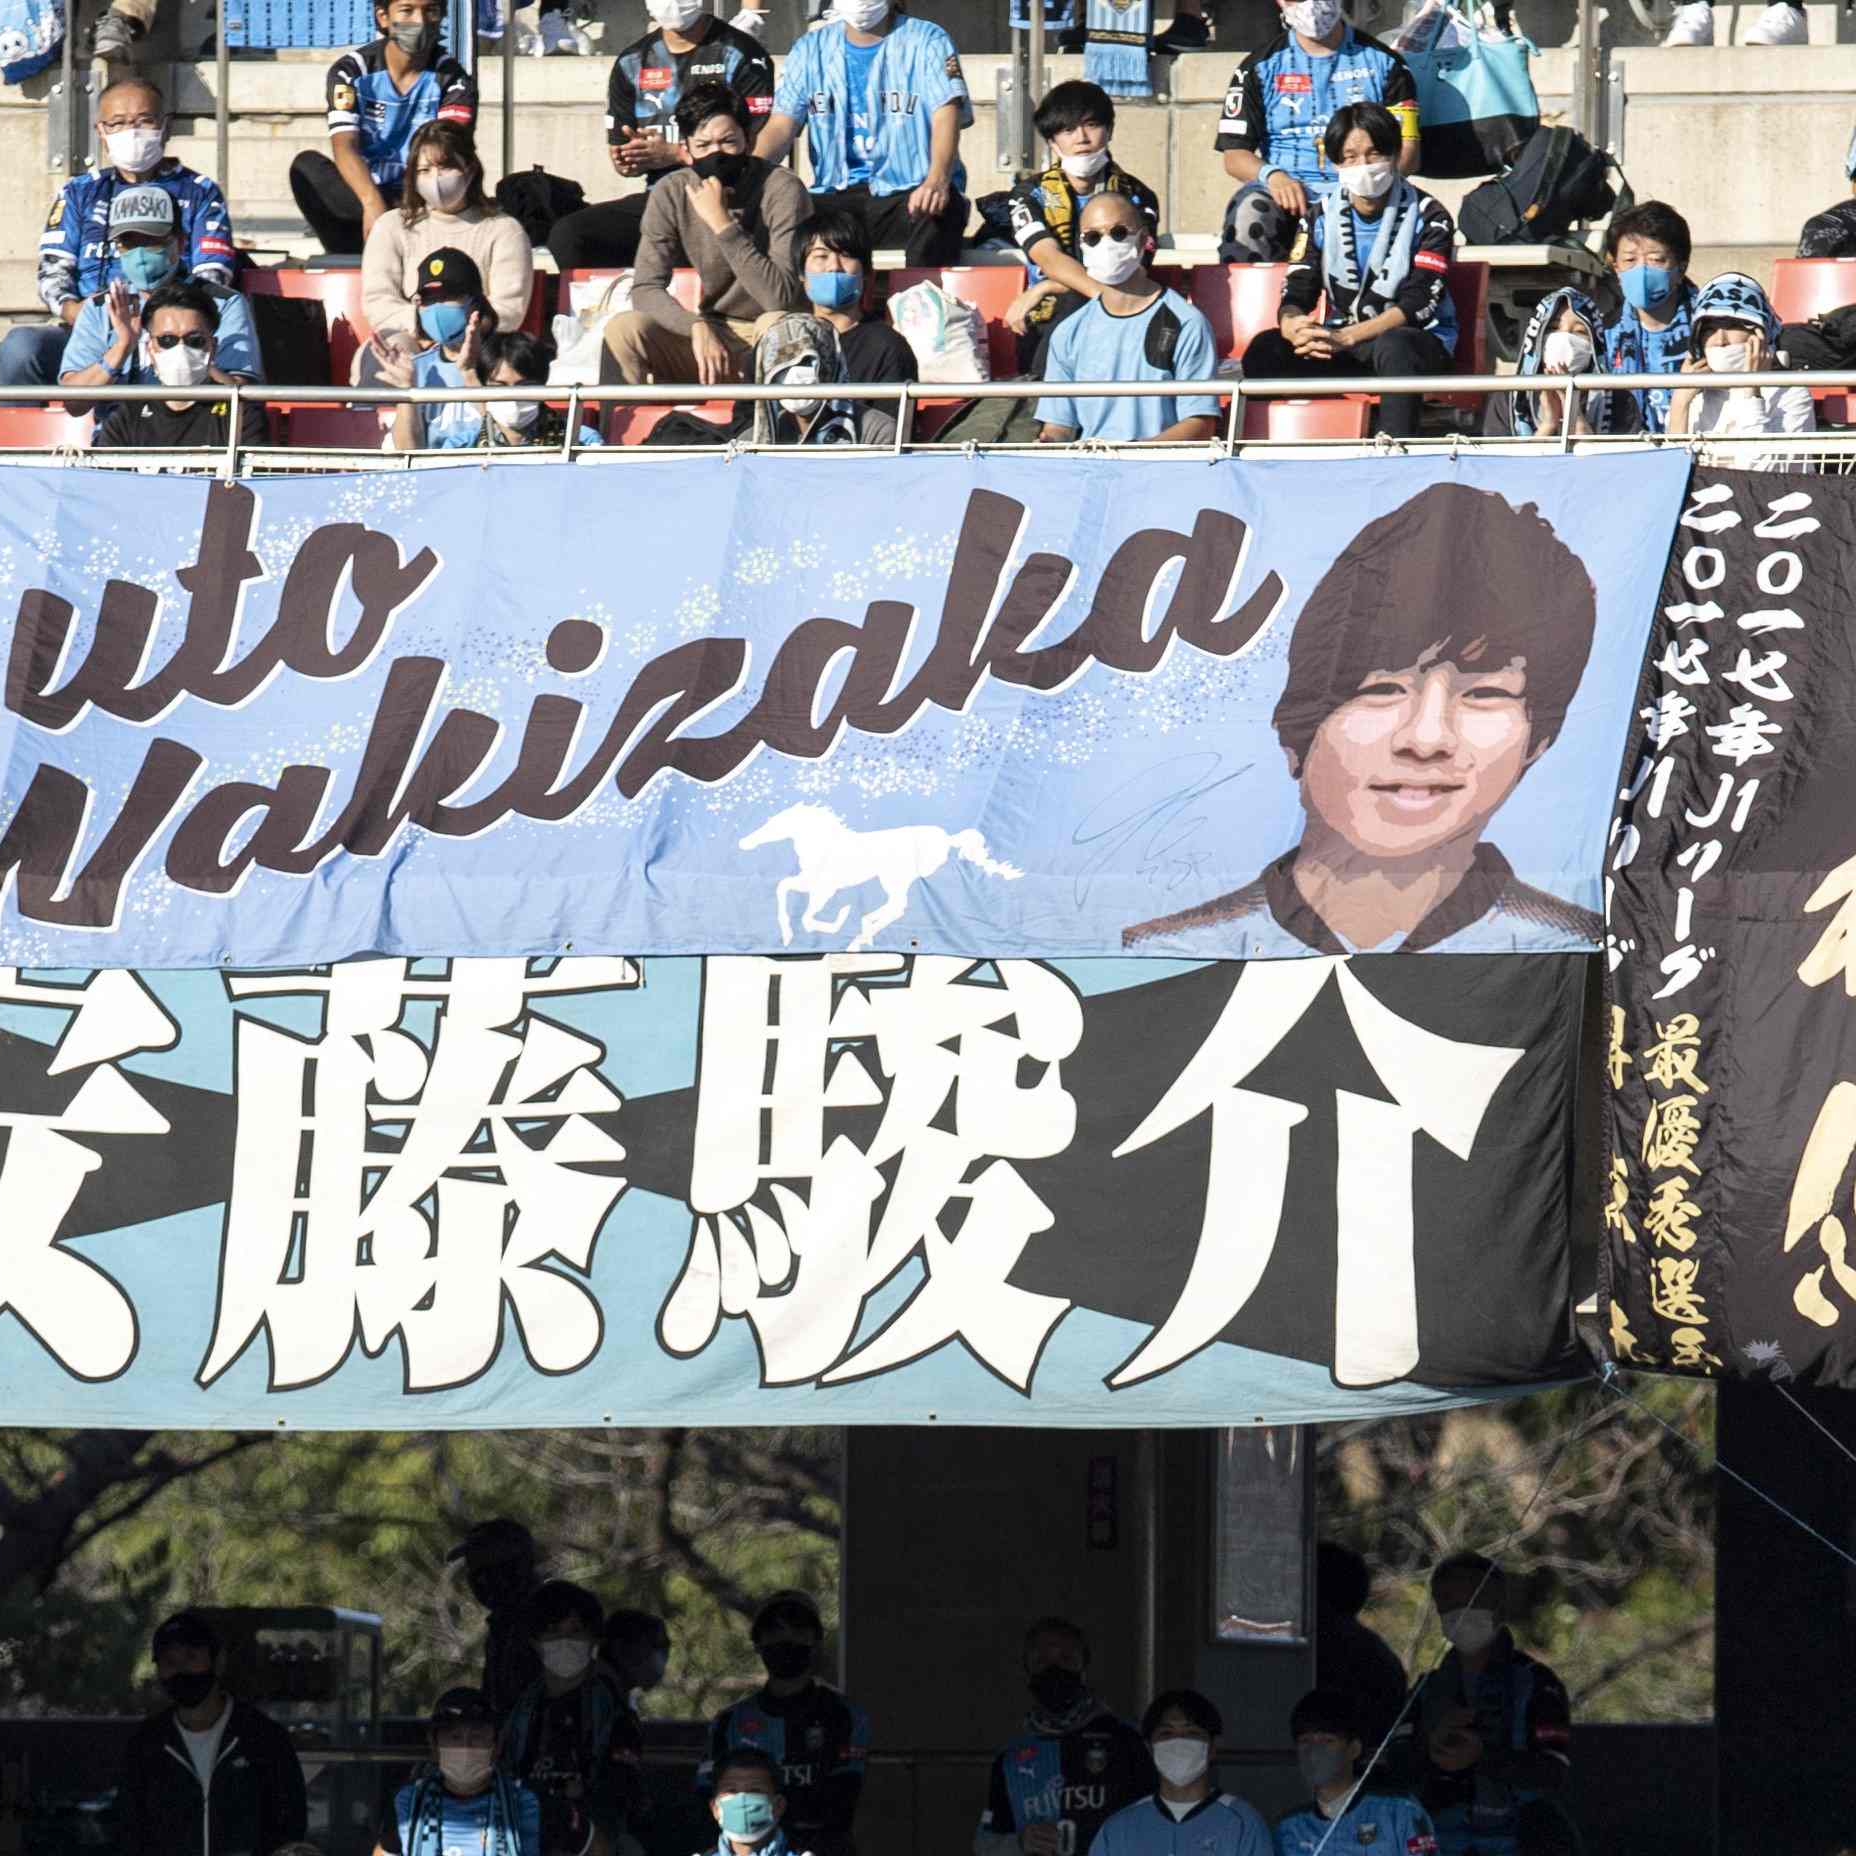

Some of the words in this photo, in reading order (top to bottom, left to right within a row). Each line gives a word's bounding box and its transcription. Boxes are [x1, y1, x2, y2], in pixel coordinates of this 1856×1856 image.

[1641, 1011, 1725, 1374] 最優秀選手
